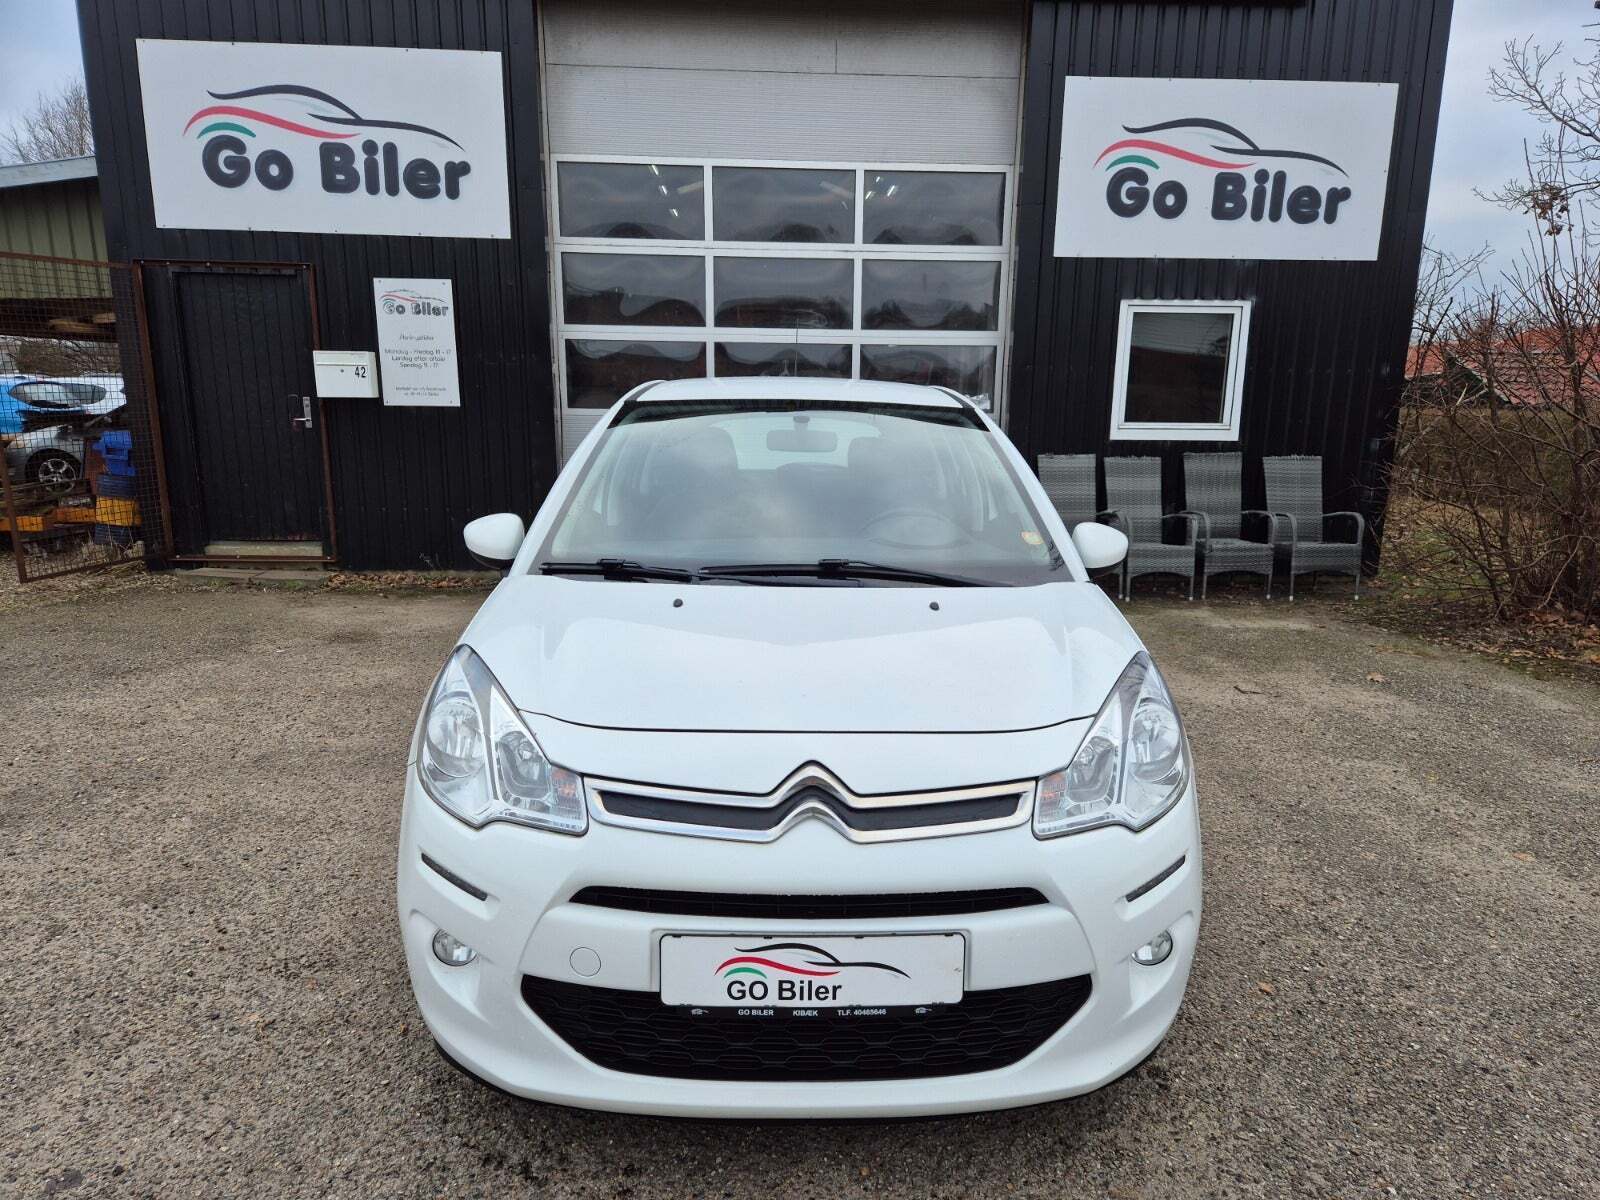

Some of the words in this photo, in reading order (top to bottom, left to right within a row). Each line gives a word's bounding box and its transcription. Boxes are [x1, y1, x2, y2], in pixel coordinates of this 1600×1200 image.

[202, 135, 294, 190] Go
[319, 139, 471, 200] Biler
[1106, 167, 1188, 219] Go
[1211, 169, 1351, 225] Biler
[383, 301, 406, 315] Go
[411, 302, 449, 316] Biler
[355, 365, 366, 378] 42
[727, 980, 769, 1000] GO
[778, 980, 842, 1001] Biler
[738, 1008, 750, 1016] GO
[751, 1008, 774, 1016] BILER
